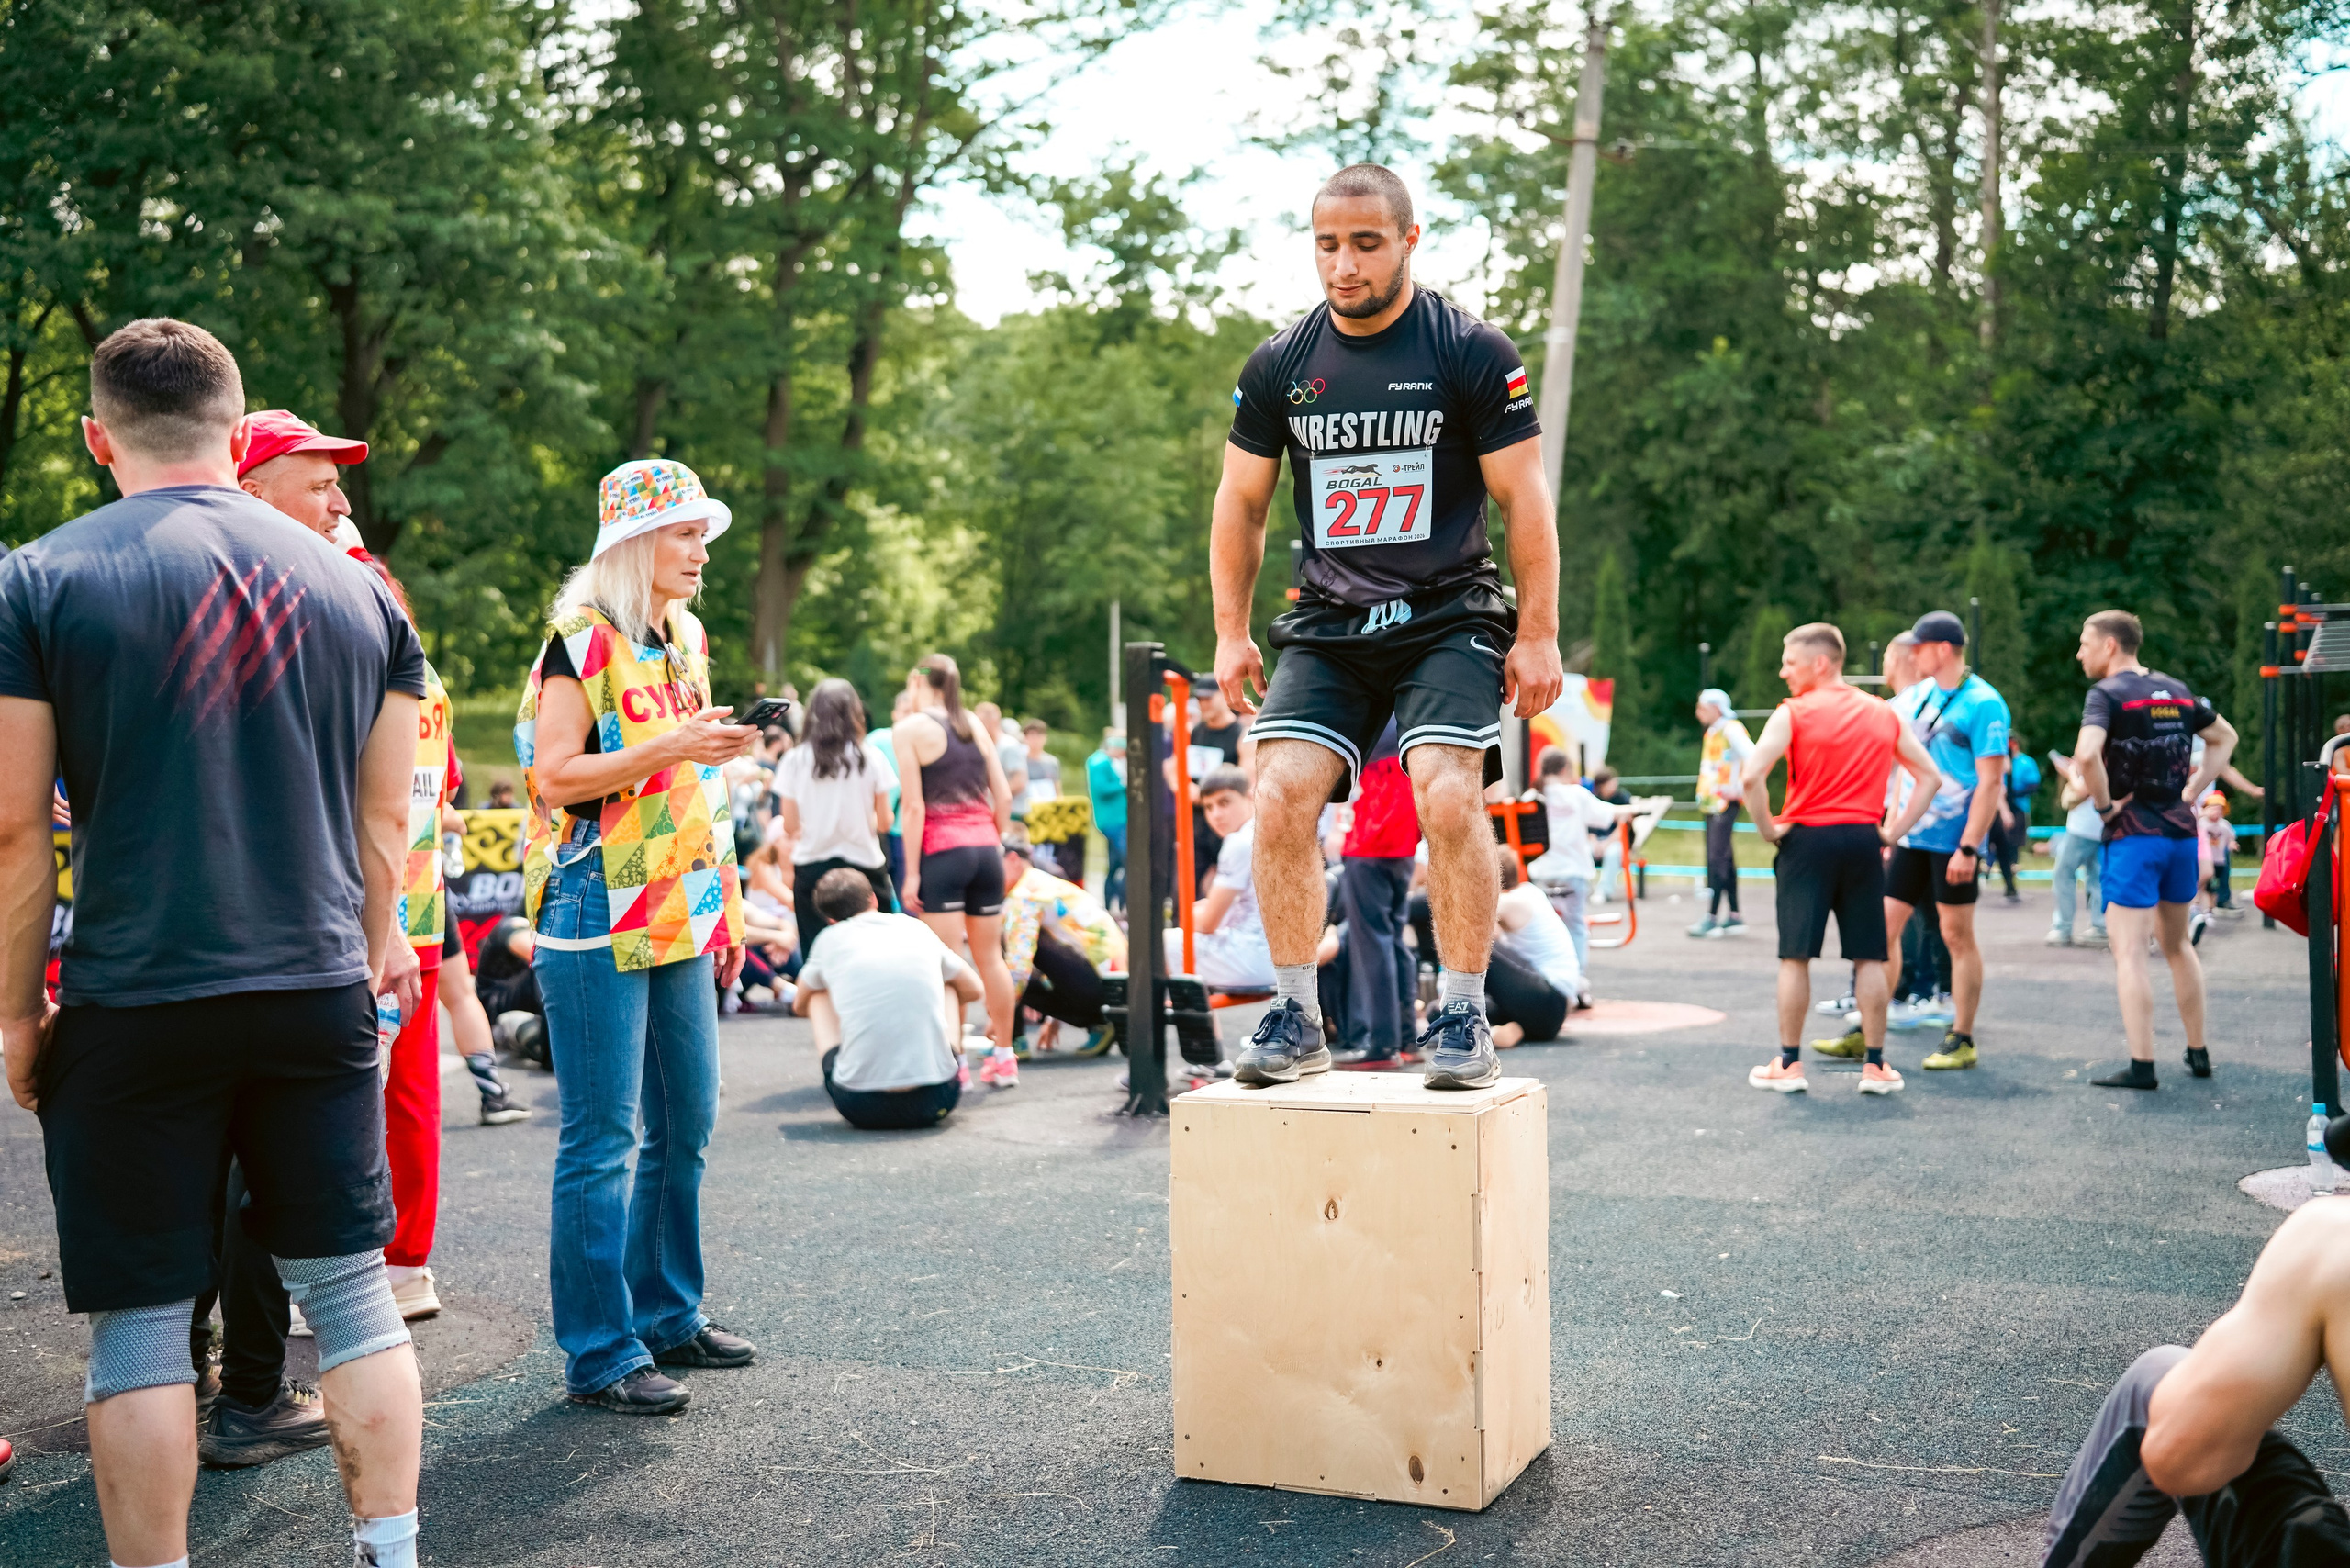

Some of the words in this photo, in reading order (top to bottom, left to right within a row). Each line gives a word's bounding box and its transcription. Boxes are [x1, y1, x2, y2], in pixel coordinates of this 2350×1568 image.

[1388, 382, 1432, 390] FYRANK
[1288, 410, 1444, 451] WRESTLING
[1326, 476, 1382, 490] BOGAL
[1325, 484, 1425, 538] 277
[1377, 535, 1414, 543] МАРАФОН
[621, 676, 712, 723] СУД
[1270, 997, 1287, 1007] EA7
[1448, 1002, 1470, 1011] EA7
